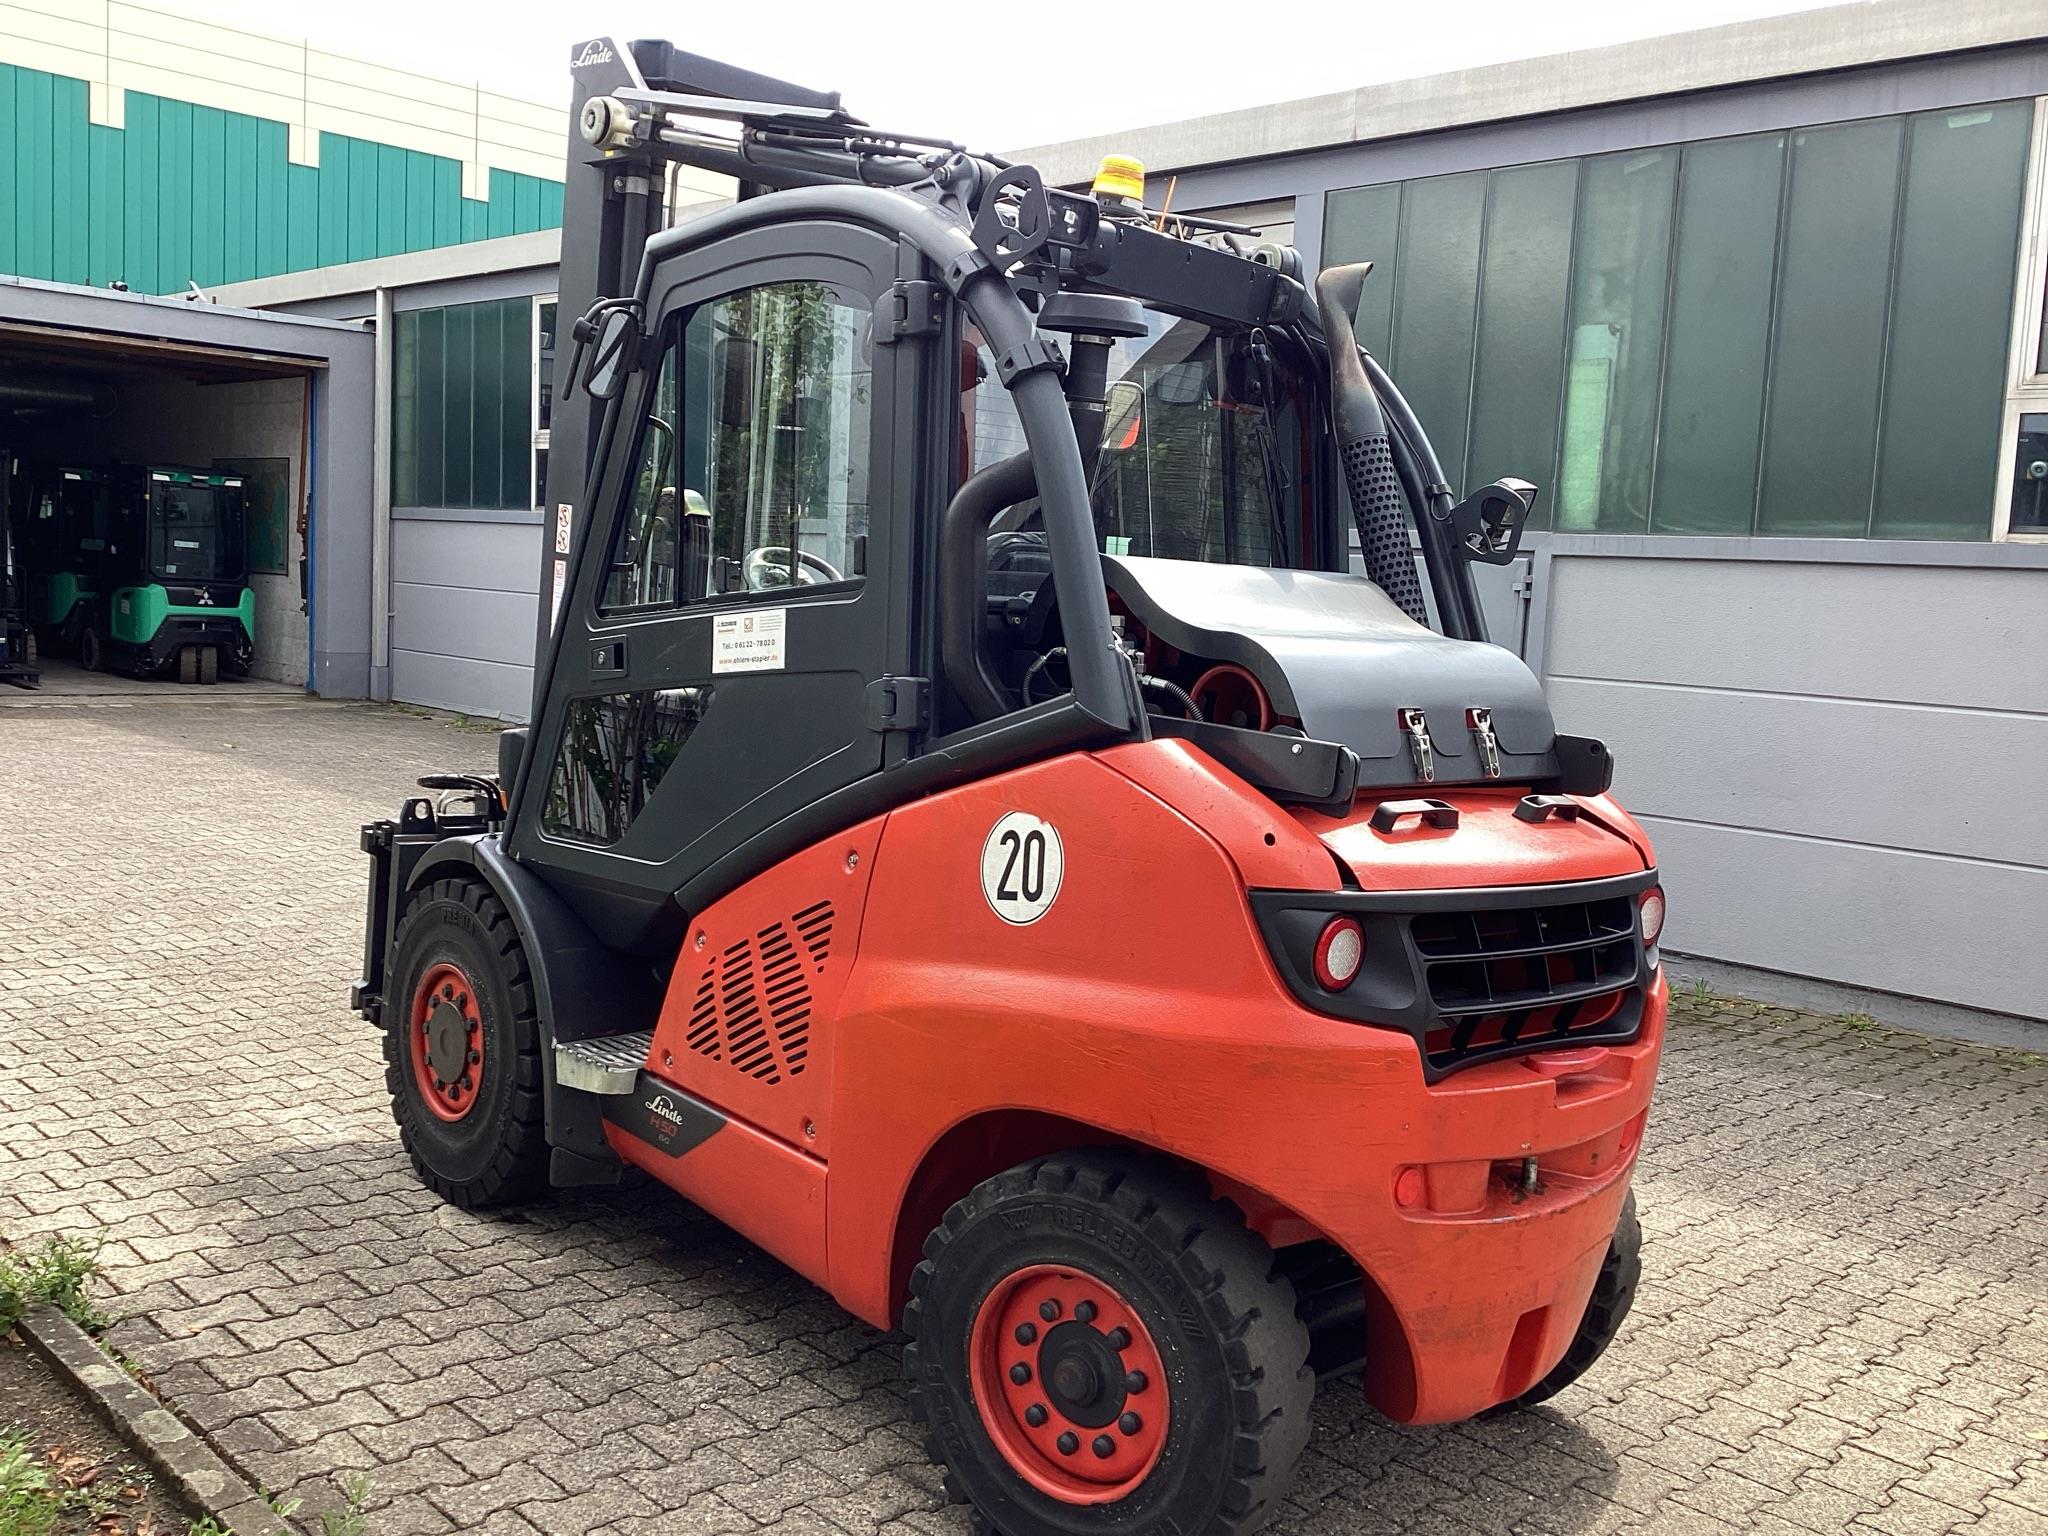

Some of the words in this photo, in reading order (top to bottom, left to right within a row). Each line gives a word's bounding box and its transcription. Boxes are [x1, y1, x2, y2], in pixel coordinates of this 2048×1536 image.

[571, 40, 612, 68] Linde
[997, 830, 1046, 903] 20
[645, 1095, 683, 1125] Linde
[1041, 1203, 1179, 1297] TRELLEBORG
